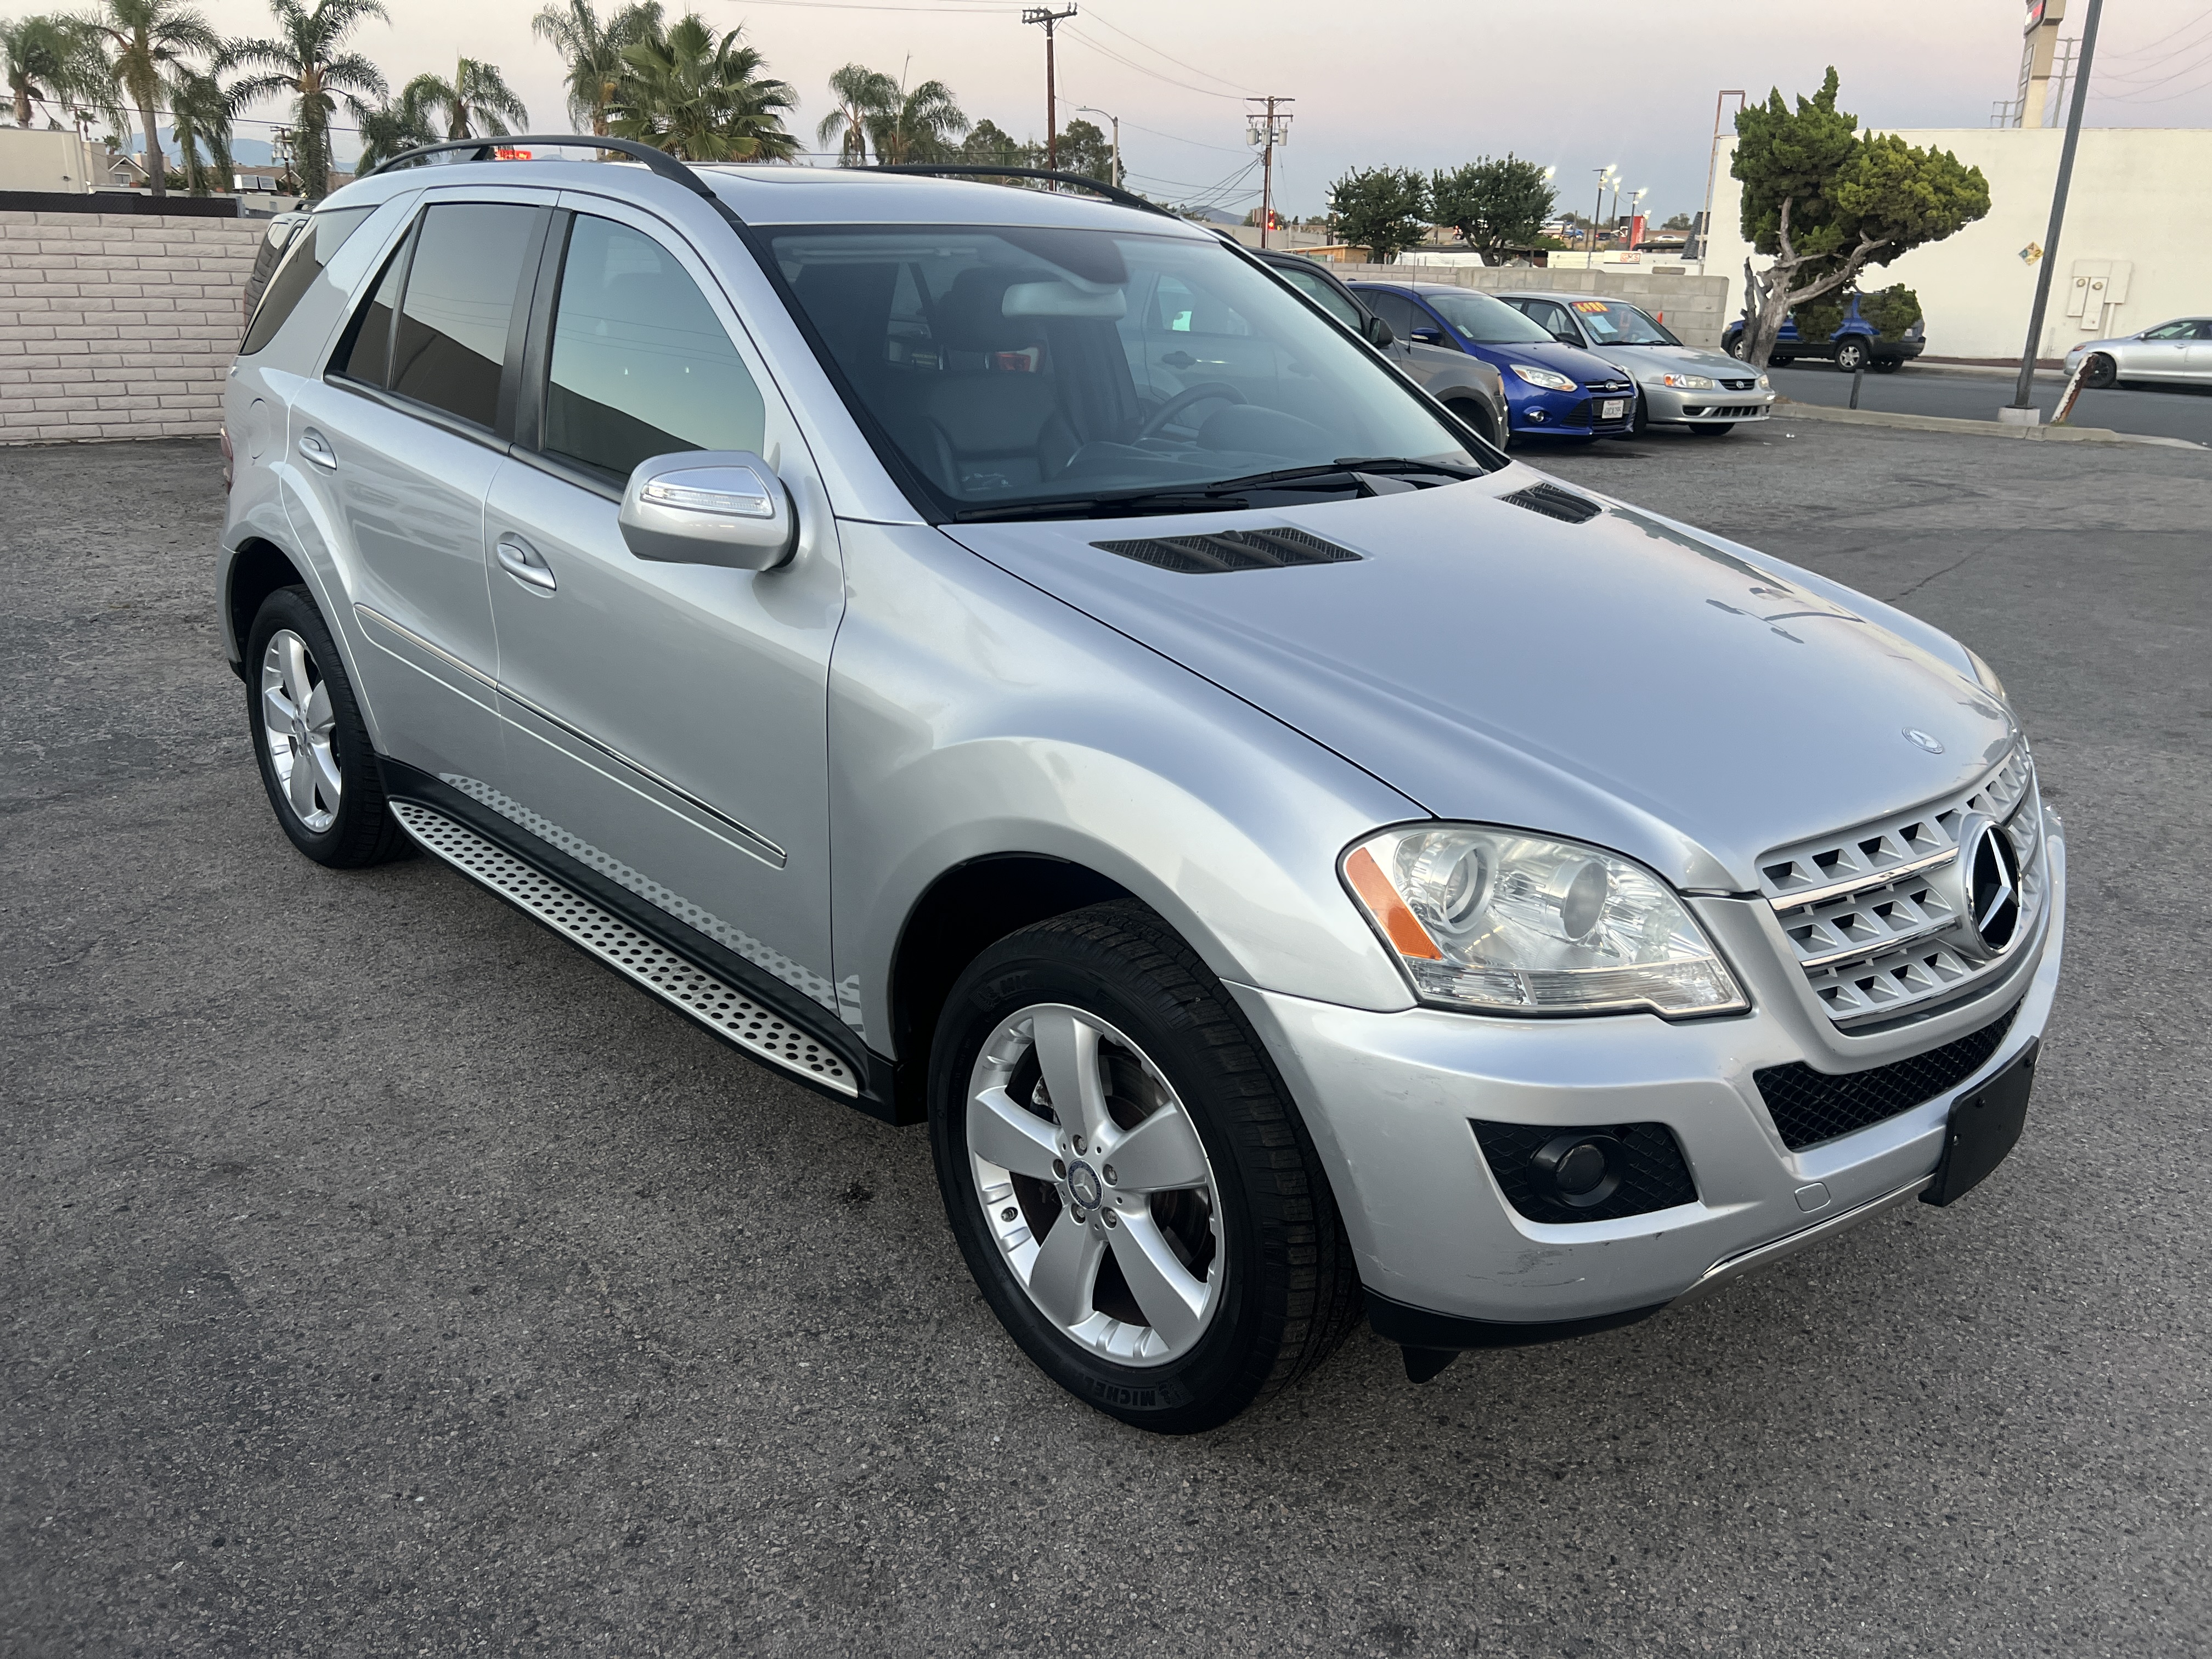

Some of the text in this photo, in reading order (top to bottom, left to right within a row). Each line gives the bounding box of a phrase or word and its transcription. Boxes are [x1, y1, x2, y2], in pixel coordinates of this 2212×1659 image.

[2028, 242, 2034, 250] 4
[2035, 249, 2041, 257] 2
[1577, 301, 1609, 312] 6480
[1083, 1375, 1156, 1407] MICHEL
